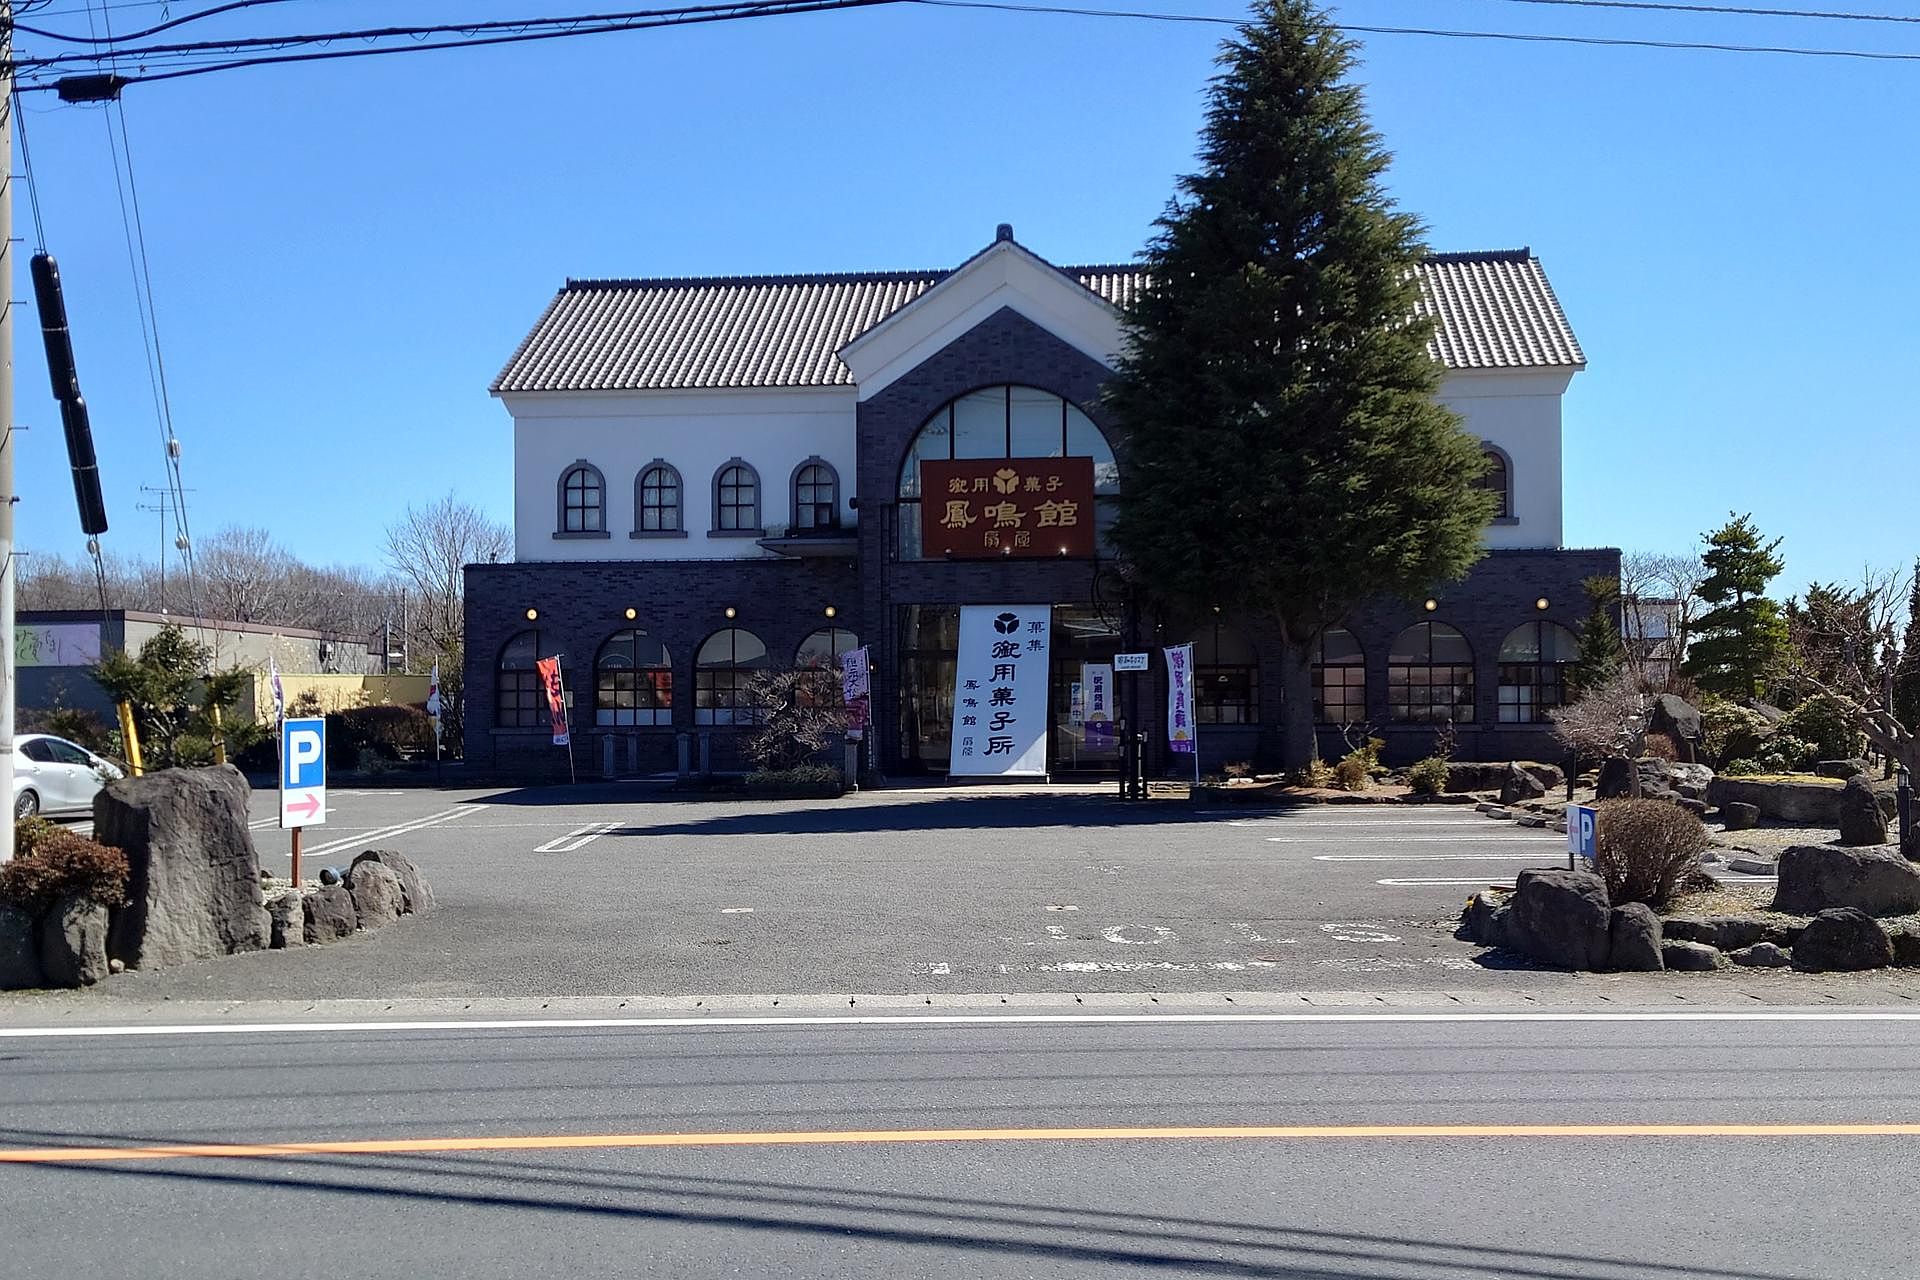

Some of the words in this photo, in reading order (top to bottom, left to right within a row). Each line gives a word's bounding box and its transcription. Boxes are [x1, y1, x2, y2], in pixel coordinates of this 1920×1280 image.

[1023, 475, 1064, 492] 菓子
[940, 499, 1079, 528] 鳳鳴館
[983, 641, 1022, 756] 御用菓子所
[289, 730, 322, 785] P
[1581, 813, 1593, 851] P
